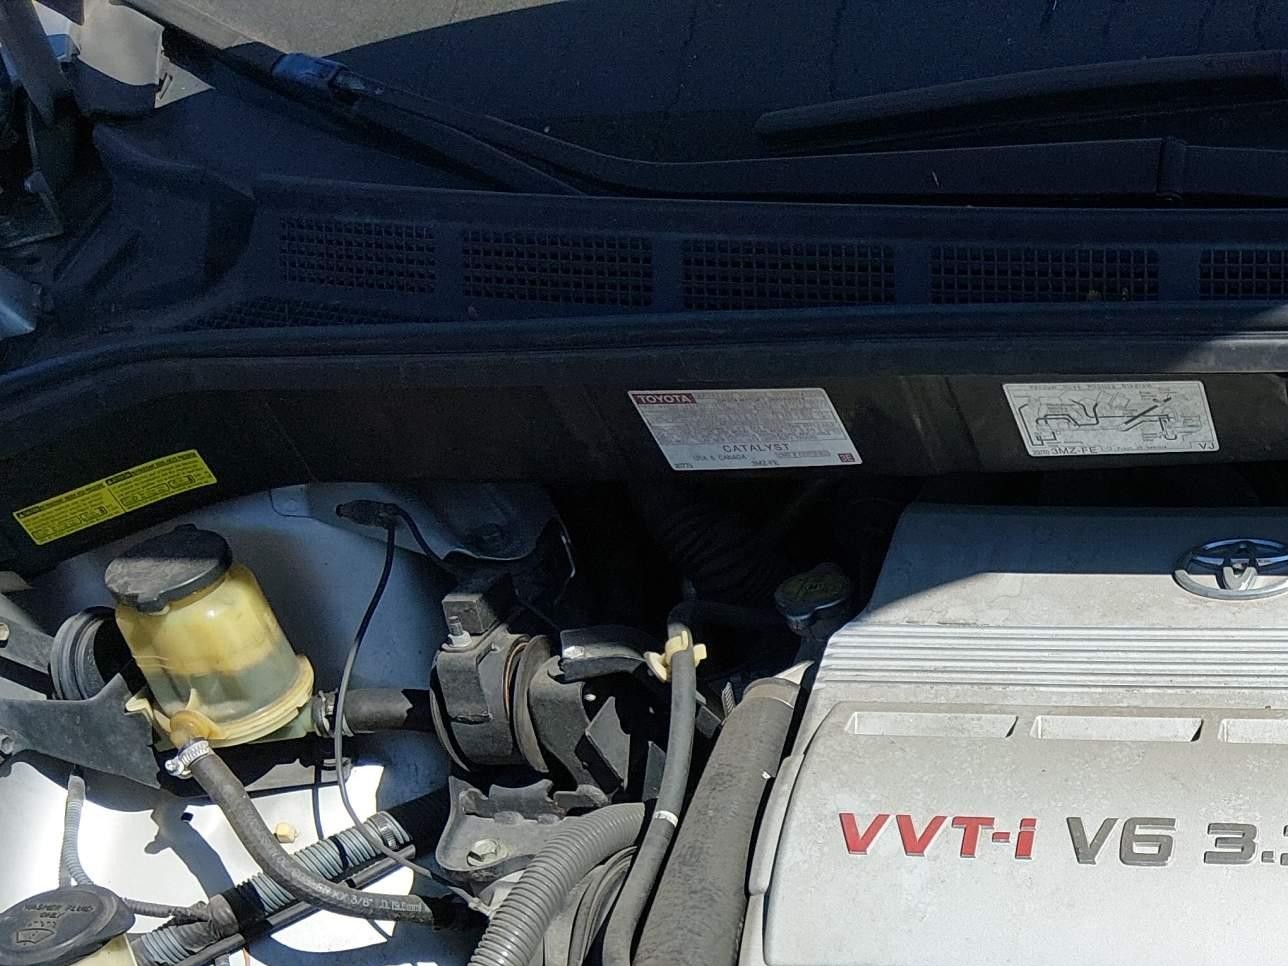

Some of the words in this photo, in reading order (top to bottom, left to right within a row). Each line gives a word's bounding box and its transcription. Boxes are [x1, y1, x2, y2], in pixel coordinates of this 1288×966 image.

[636, 394, 691, 404] TOYOTA
[722, 443, 791, 453] CATALYST
[838, 812, 1038, 860] VVT-i
[1065, 816, 1177, 866] V6
